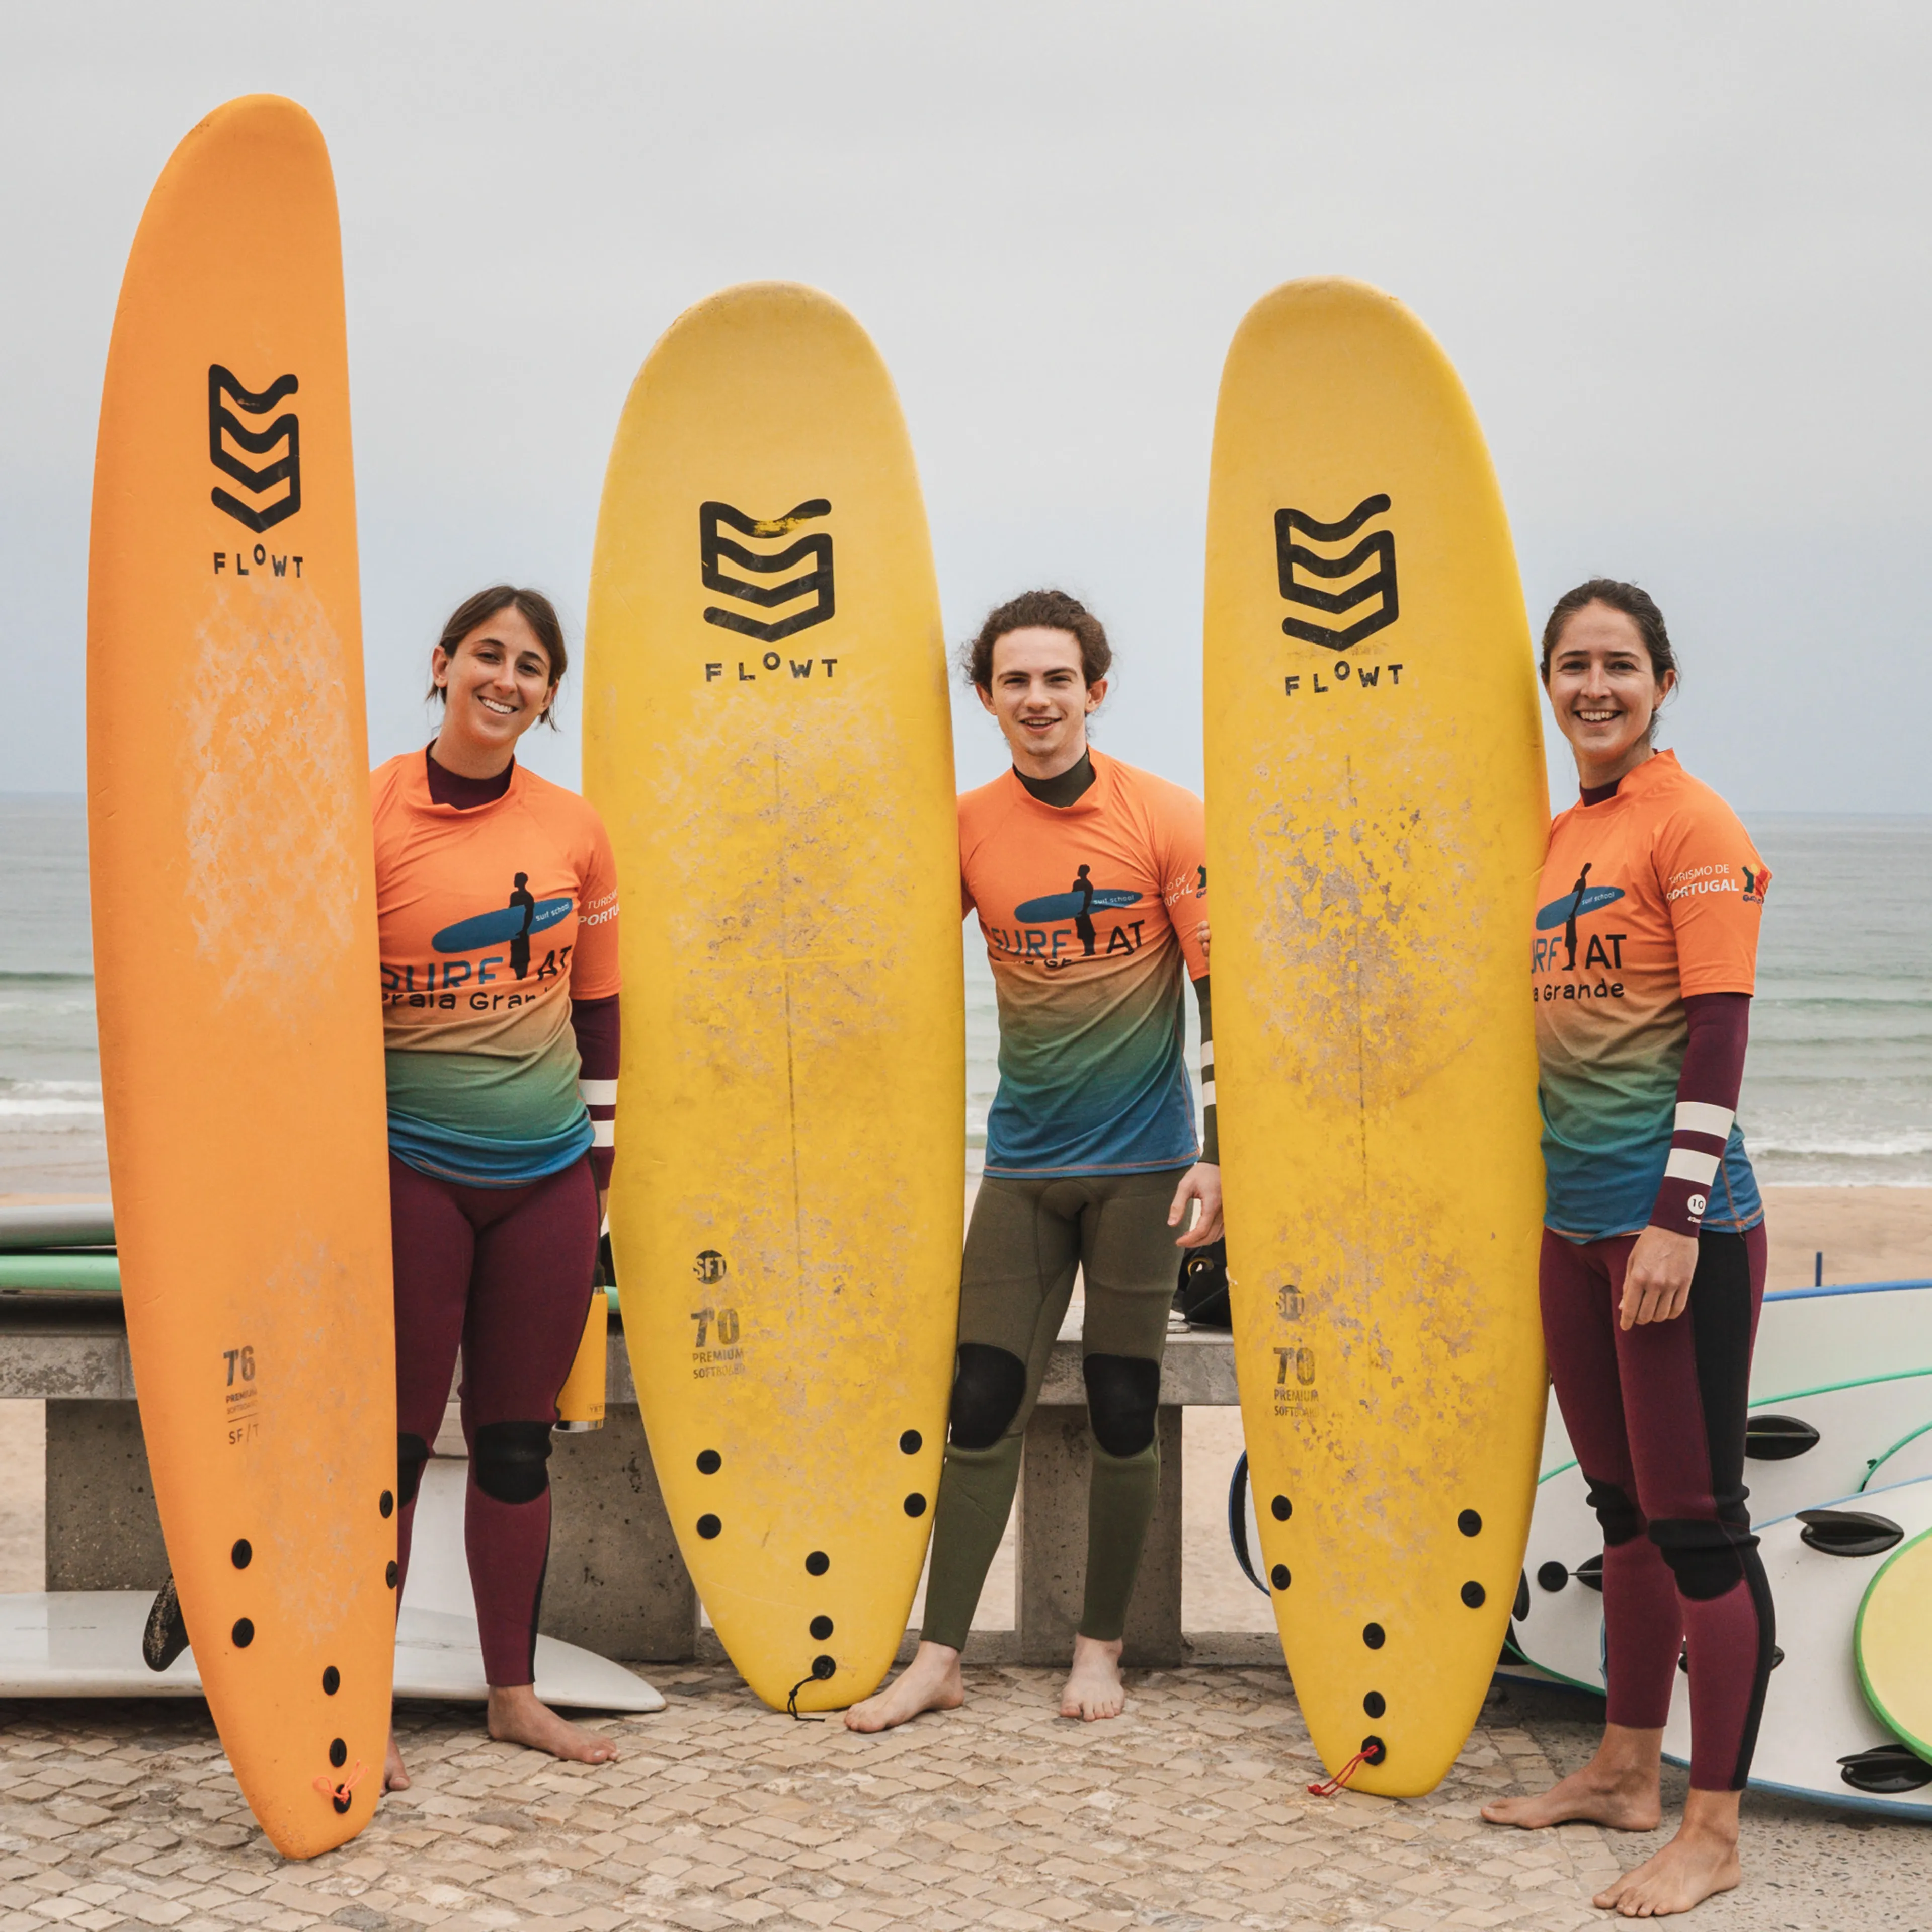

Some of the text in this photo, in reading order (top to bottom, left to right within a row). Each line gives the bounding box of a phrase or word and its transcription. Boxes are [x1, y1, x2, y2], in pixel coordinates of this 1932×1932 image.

[214, 543, 303, 578] FLOWT
[705, 652, 837, 682] FLOWT
[1285, 660, 1403, 696] FLOWT
[1175, 873, 1186, 887] DE
[1668, 864, 1730, 884] TURISMO DE
[1110, 895, 1135, 903] school
[1582, 891, 1615, 905] surf school
[1667, 879, 1739, 901] PORTUGAL
[535, 902, 570, 922] surf school
[991, 920, 1145, 958] SURF AT
[1585, 934, 1627, 970] AT
[537, 945, 573, 981] AT
[1543, 978, 1625, 1001] Grande
[1692, 1198, 1705, 1210] 10
[692, 1348, 744, 1363] PREMIUM
[1274, 1389, 1319, 1403] PREMIUM
